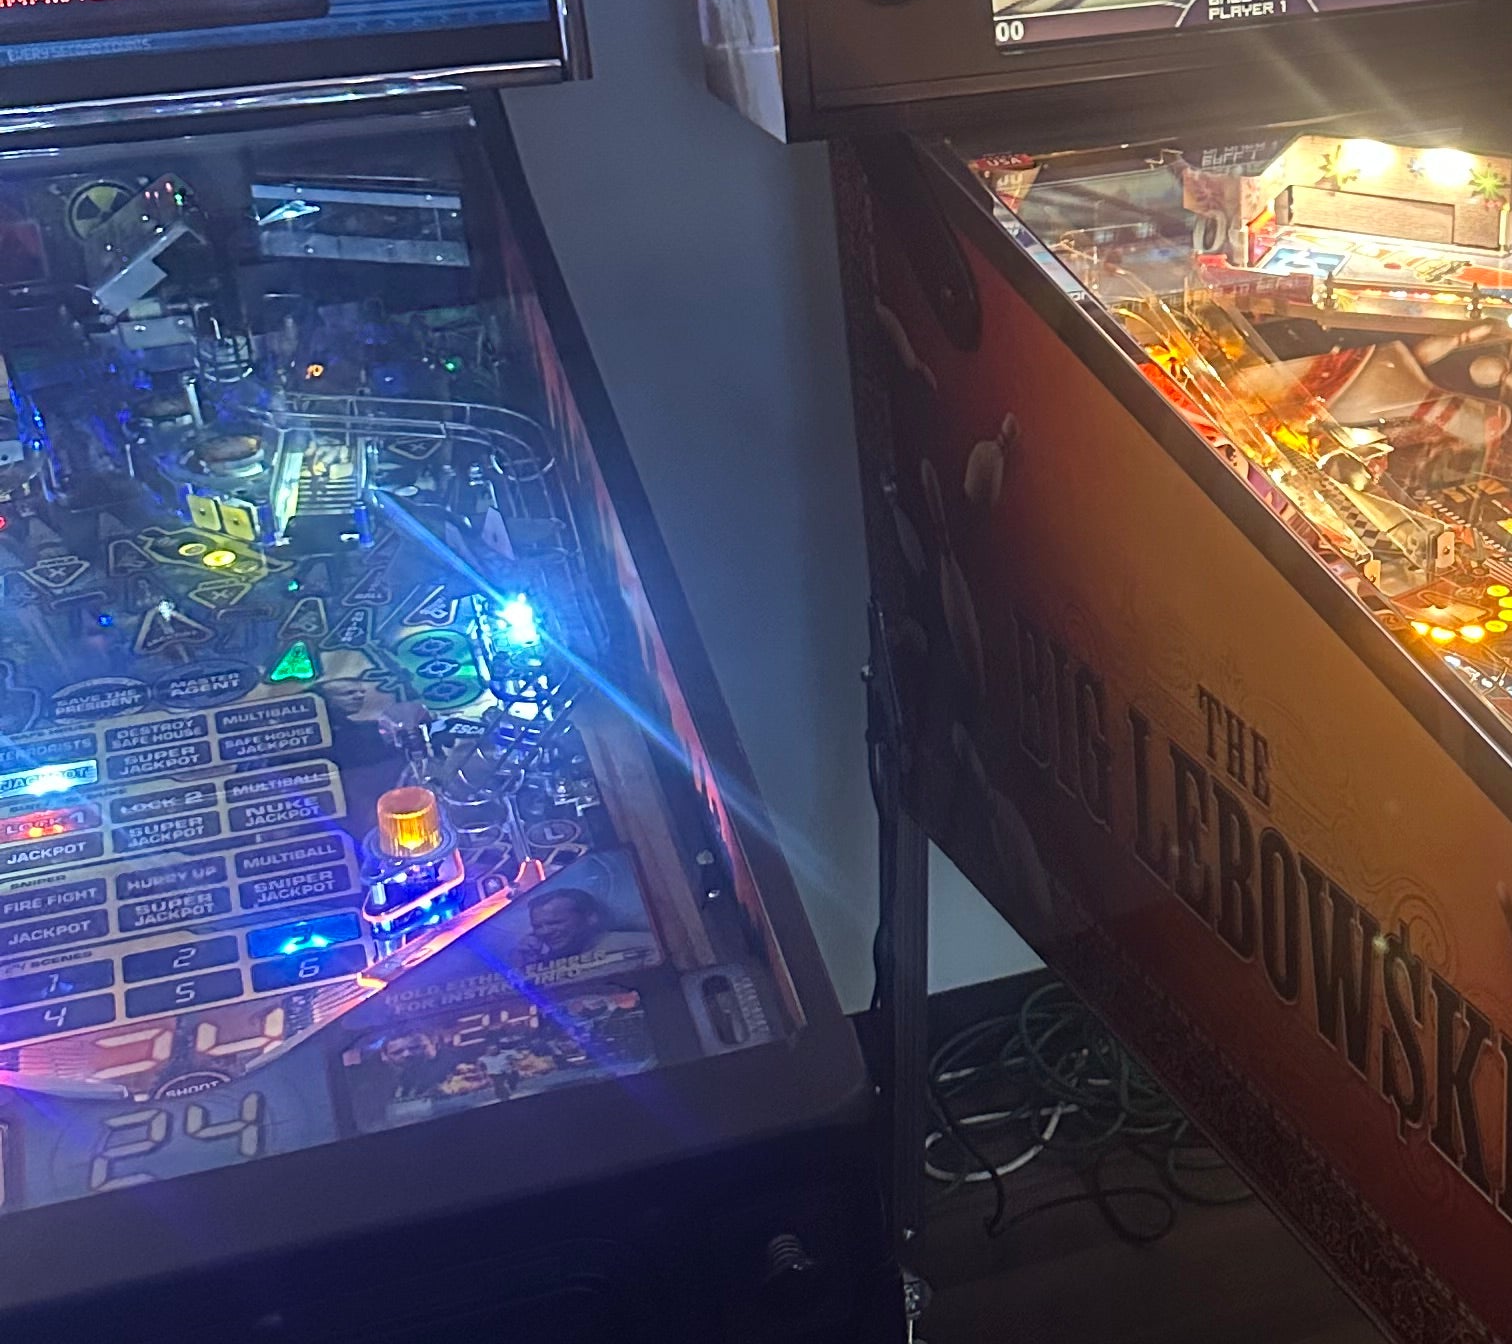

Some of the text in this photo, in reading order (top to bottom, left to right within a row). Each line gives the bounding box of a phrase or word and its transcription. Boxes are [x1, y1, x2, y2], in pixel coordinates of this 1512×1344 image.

[1208, 0, 1288, 21] PLAYER 1
[995, 21, 1025, 44] 00
[170, 679, 241, 697] AGENT
[55, 694, 141, 716] PRESIDENT
[222, 704, 311, 725] MULTIBALL
[117, 720, 194, 739] DESTROY
[152, 727, 201, 743] HOUSE
[1012, 618, 1112, 834] BIG
[124, 745, 195, 766] SUPER
[236, 735, 310, 756] JACKPOT
[1198, 684, 1272, 808] THE
[120, 754, 200, 776] JACKPOT
[184, 790, 204, 805] 2
[245, 796, 320, 818] NUKE
[128, 816, 203, 838] SUPER
[244, 804, 320, 828] JACKPOT
[128, 824, 205, 848] JACKPOT
[7, 841, 87, 866] JACKPOT
[242, 843, 337, 870] MULTIBALL
[253, 870, 334, 894] SNIPER
[257, 879, 336, 903] JACKPOT
[4, 887, 98, 915] FIRE FIGHT
[135, 893, 213, 916] SUPER
[134, 903, 215, 927] JACKPOT
[8, 919, 91, 946] JACKPOT
[172, 947, 196, 969] 2
[298, 957, 320, 980] 6
[43, 1006, 68, 1028] 4
